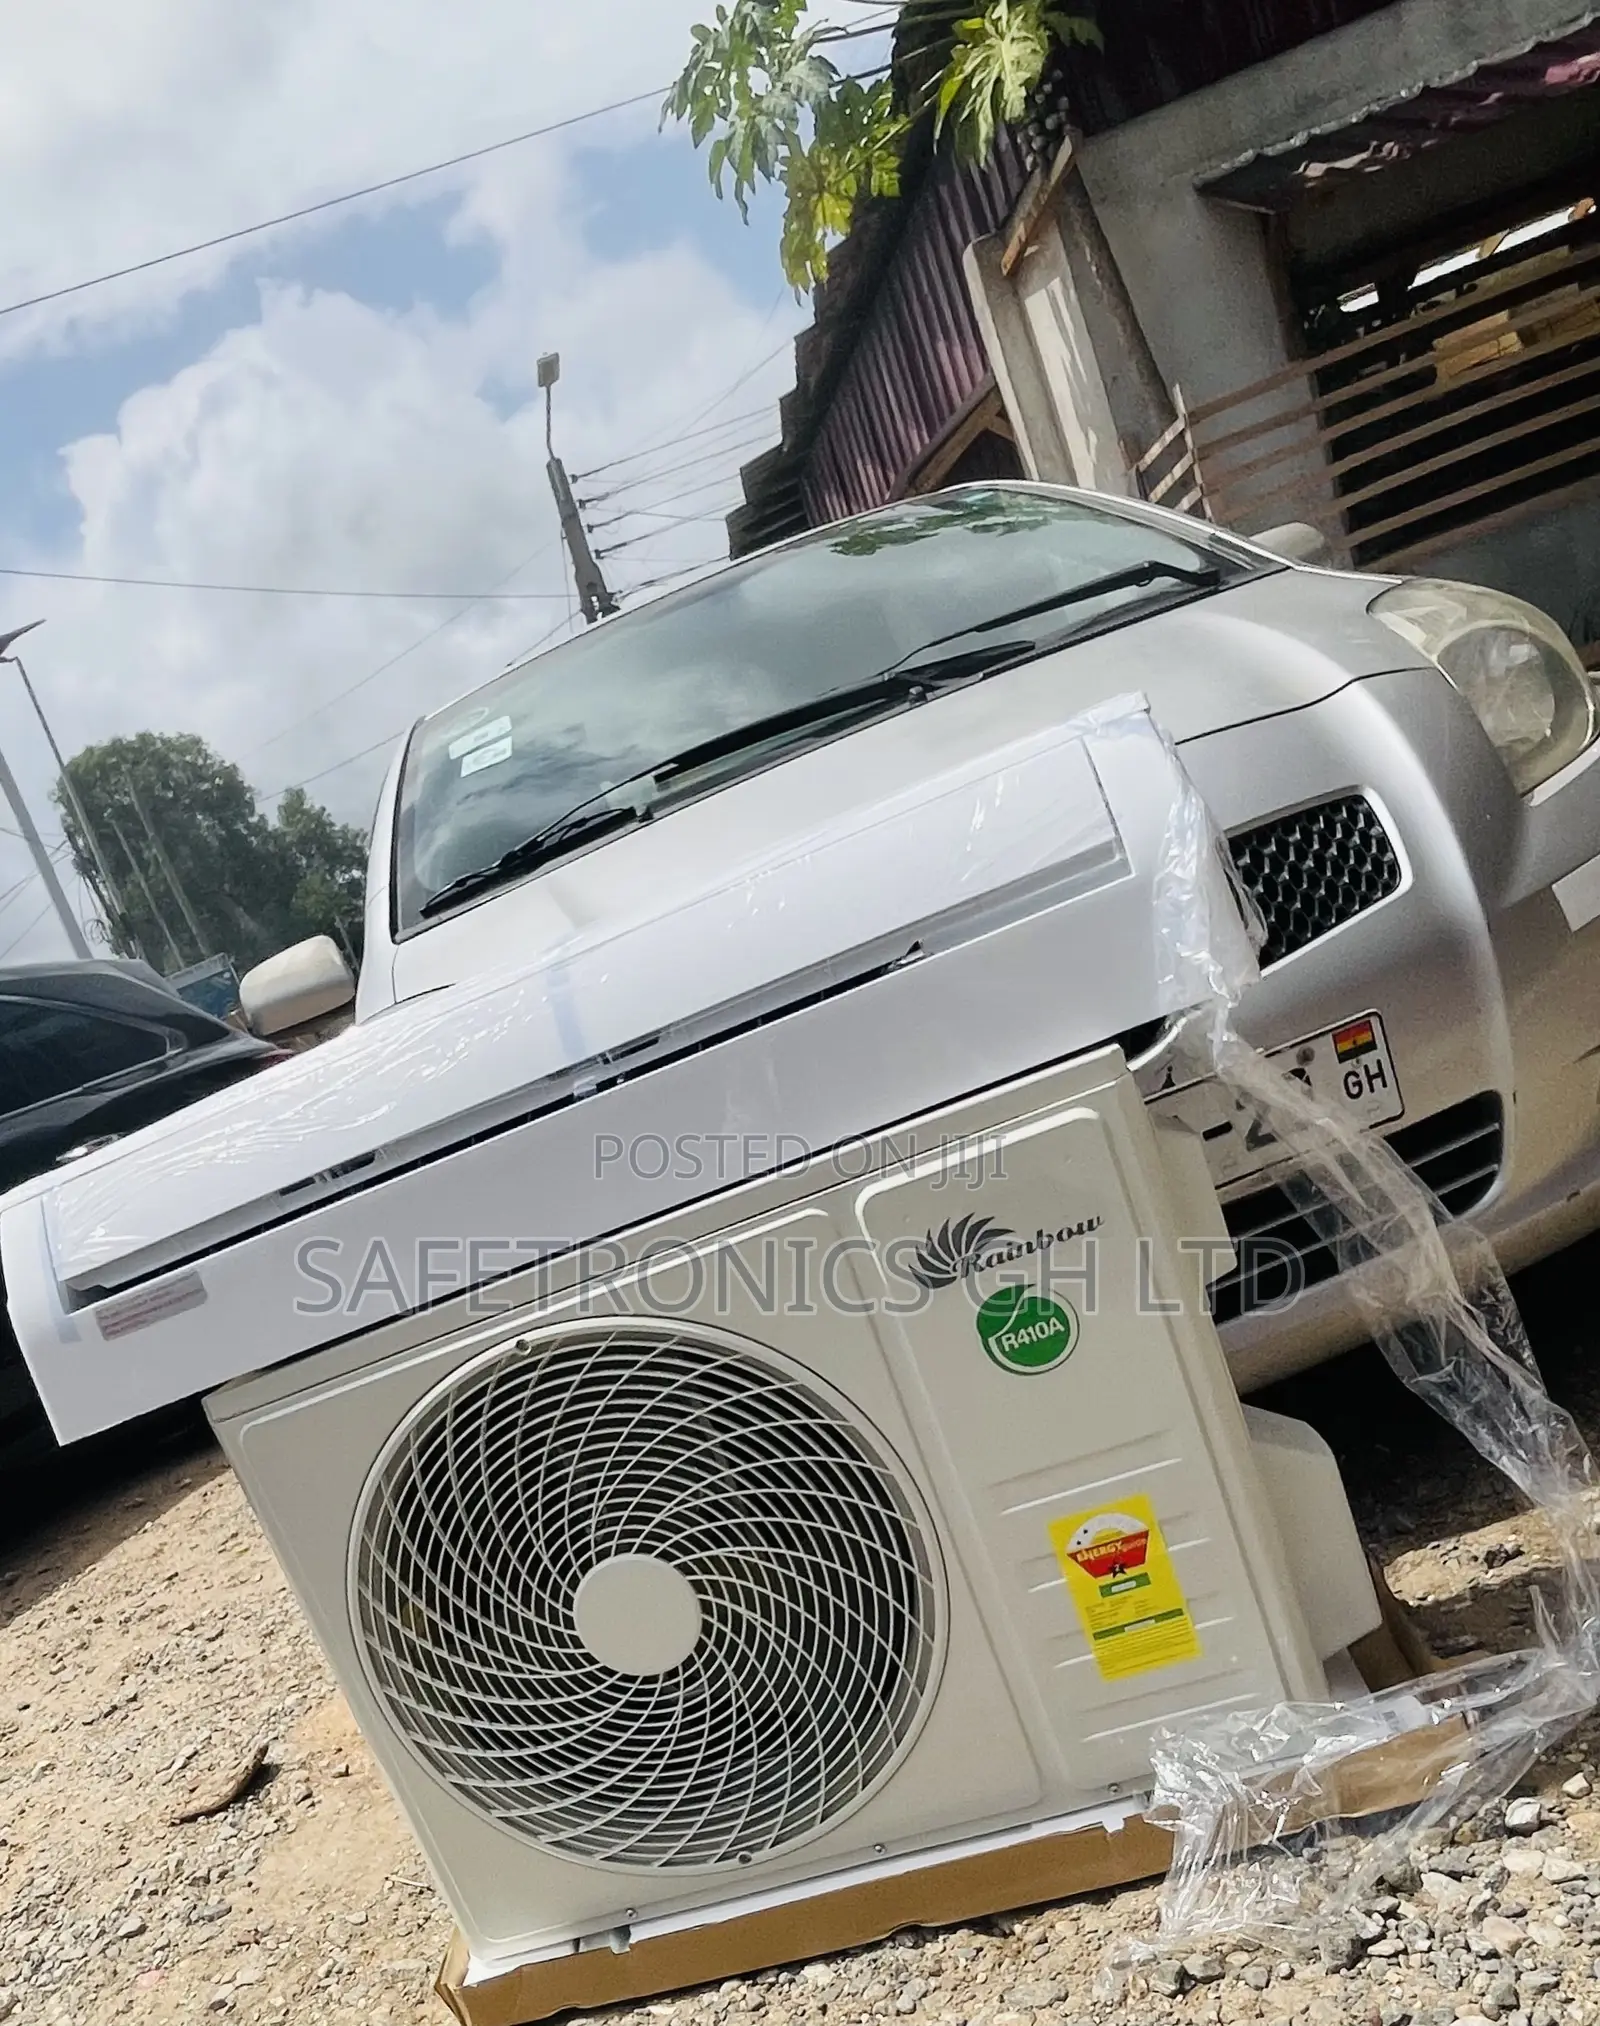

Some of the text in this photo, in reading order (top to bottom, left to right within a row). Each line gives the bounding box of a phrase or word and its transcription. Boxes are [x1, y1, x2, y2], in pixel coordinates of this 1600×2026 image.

[1342, 1058, 1388, 1100] GH
[951, 1215, 1104, 1279] Rainbow
[1001, 1315, 1066, 1353] R410A
